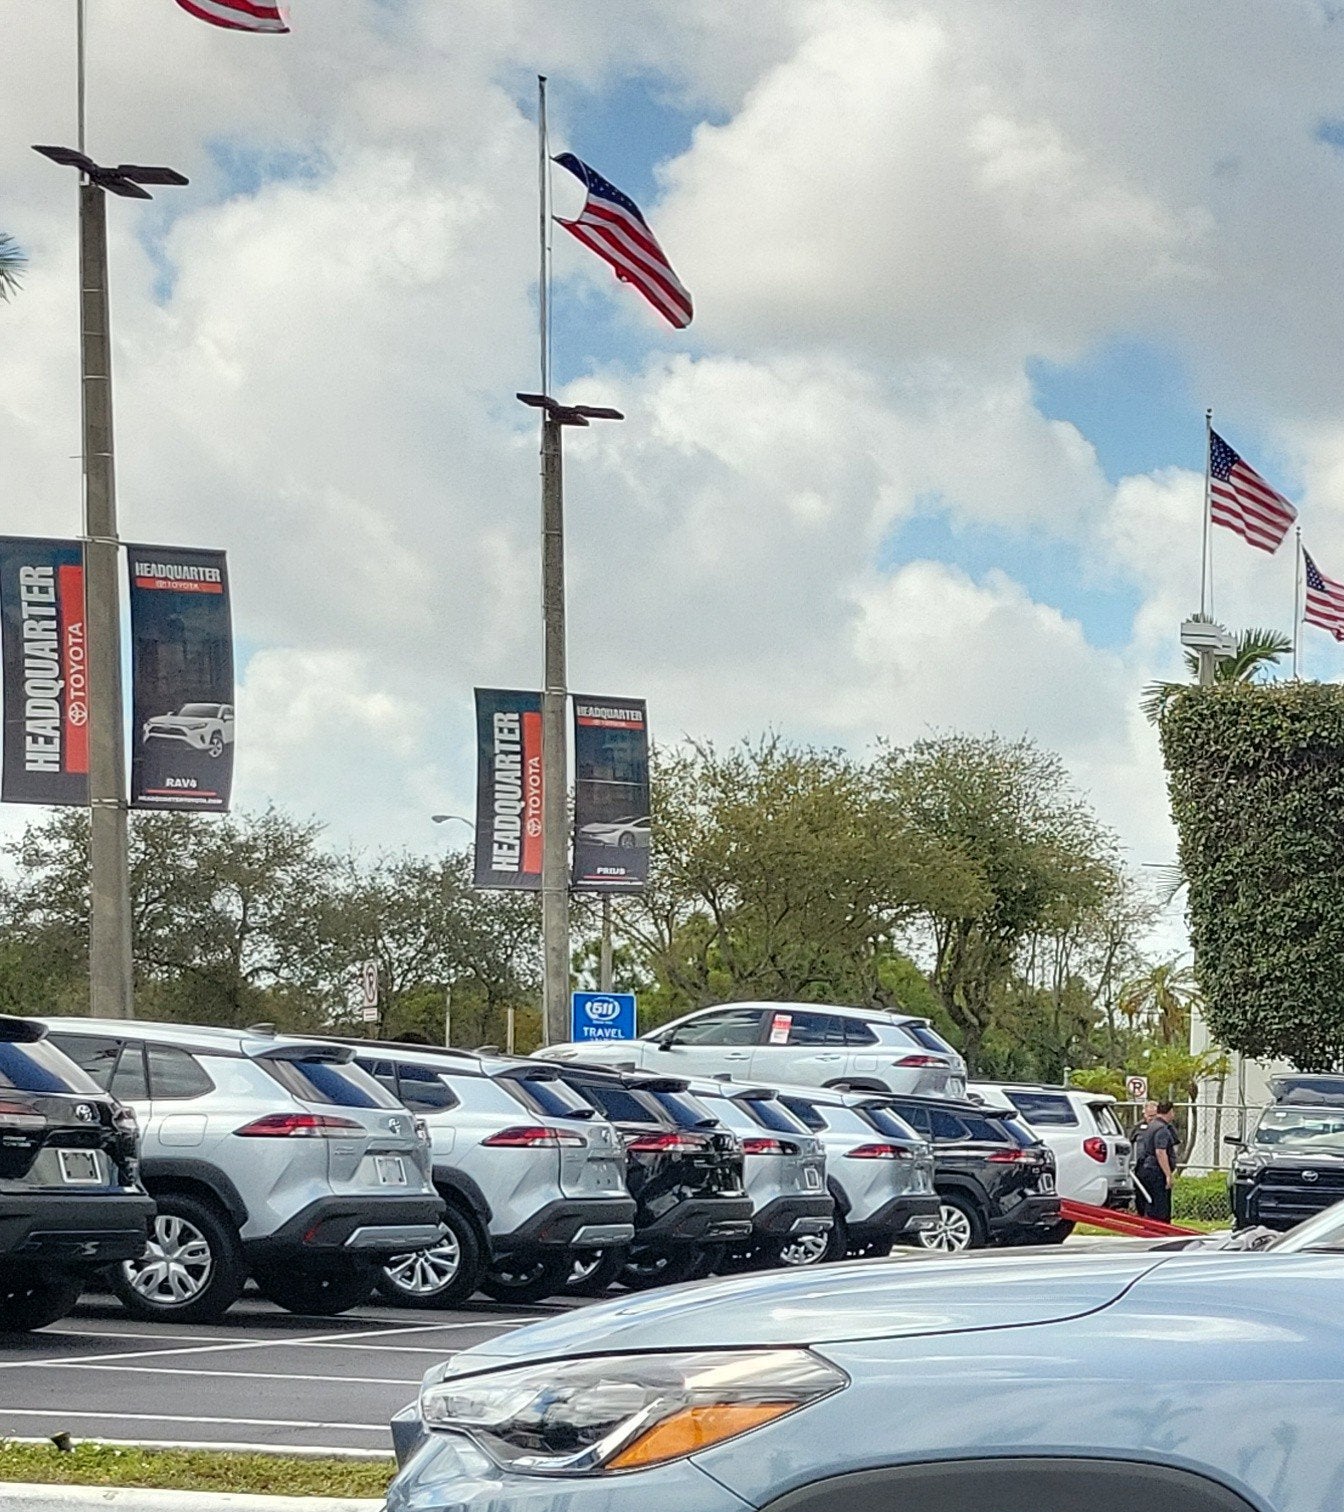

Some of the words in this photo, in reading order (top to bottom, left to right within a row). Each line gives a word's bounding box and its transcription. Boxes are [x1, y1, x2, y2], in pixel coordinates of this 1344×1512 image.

[135, 562, 221, 582] HEADQUARTER
[20, 566, 65, 772] HEADQUARTER
[68, 622, 87, 699] TOYOTA
[165, 778, 197, 788] RAV4
[492, 711, 525, 872] HEADQUARTER
[528, 757, 541, 817] TOYOTA
[592, 1002, 613, 1015] 511
[583, 1026, 625, 1038] TRAVEL
